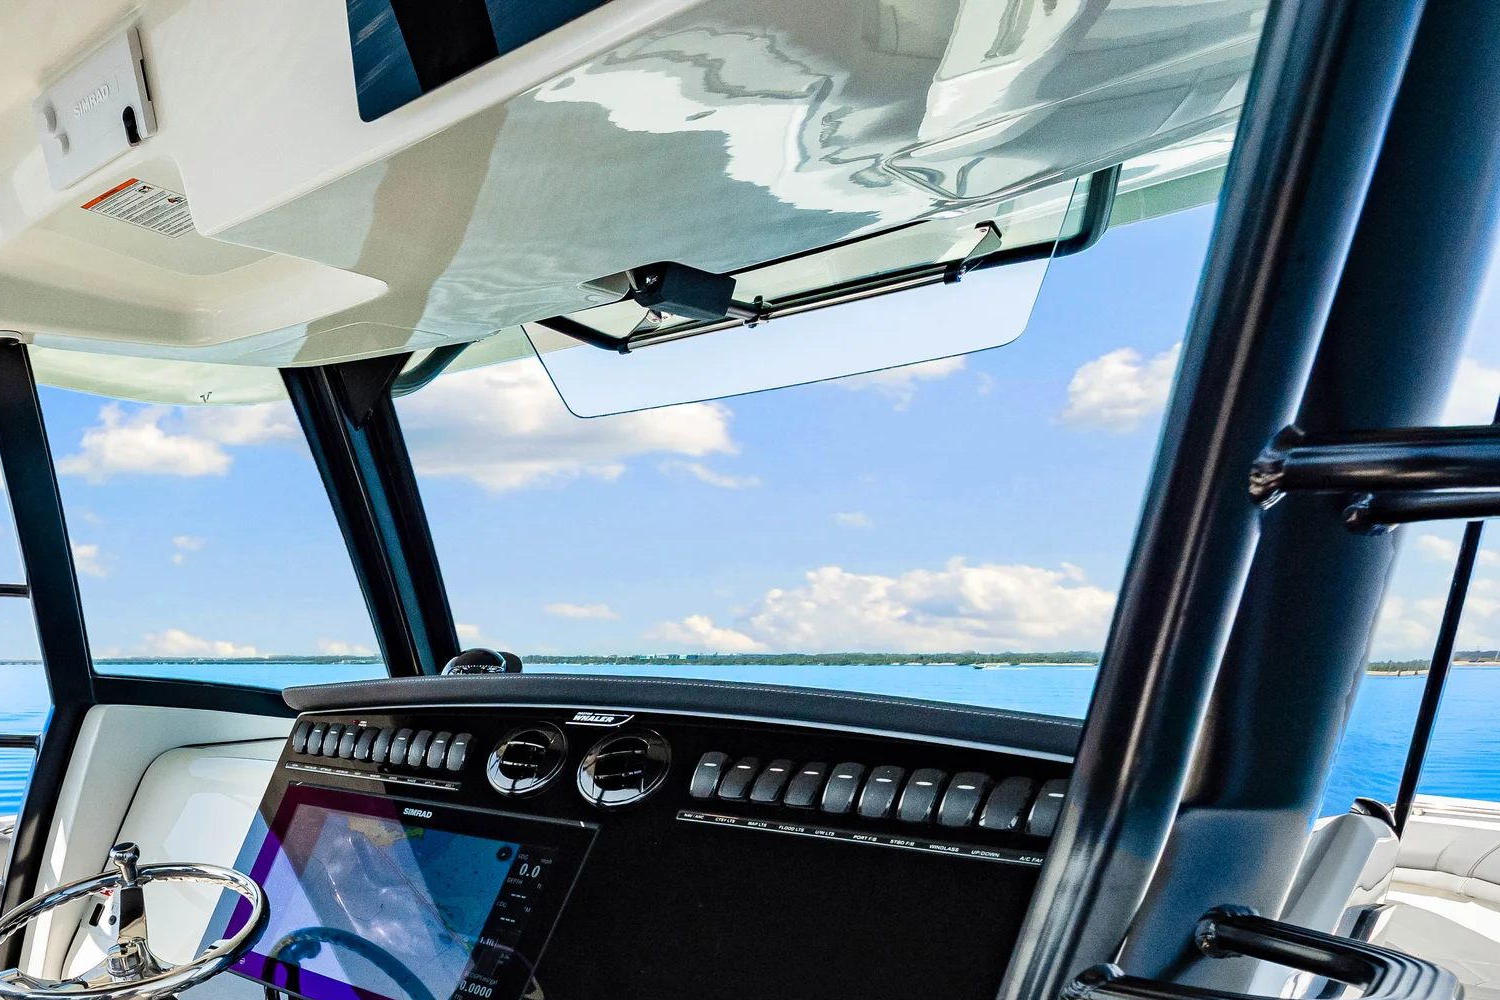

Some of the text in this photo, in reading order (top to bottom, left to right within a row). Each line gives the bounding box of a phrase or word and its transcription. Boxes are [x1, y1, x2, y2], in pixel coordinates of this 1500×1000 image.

[74, 83, 110, 117] SIMRAD
[573, 715, 615, 723] WHALER
[403, 807, 433, 819] SIMRAD
[929, 844, 959, 853] WINDLASS
[519, 863, 540, 878] 0.0
[507, 877, 523, 885] DEPTH
[460, 980, 492, 998] 0.0000
